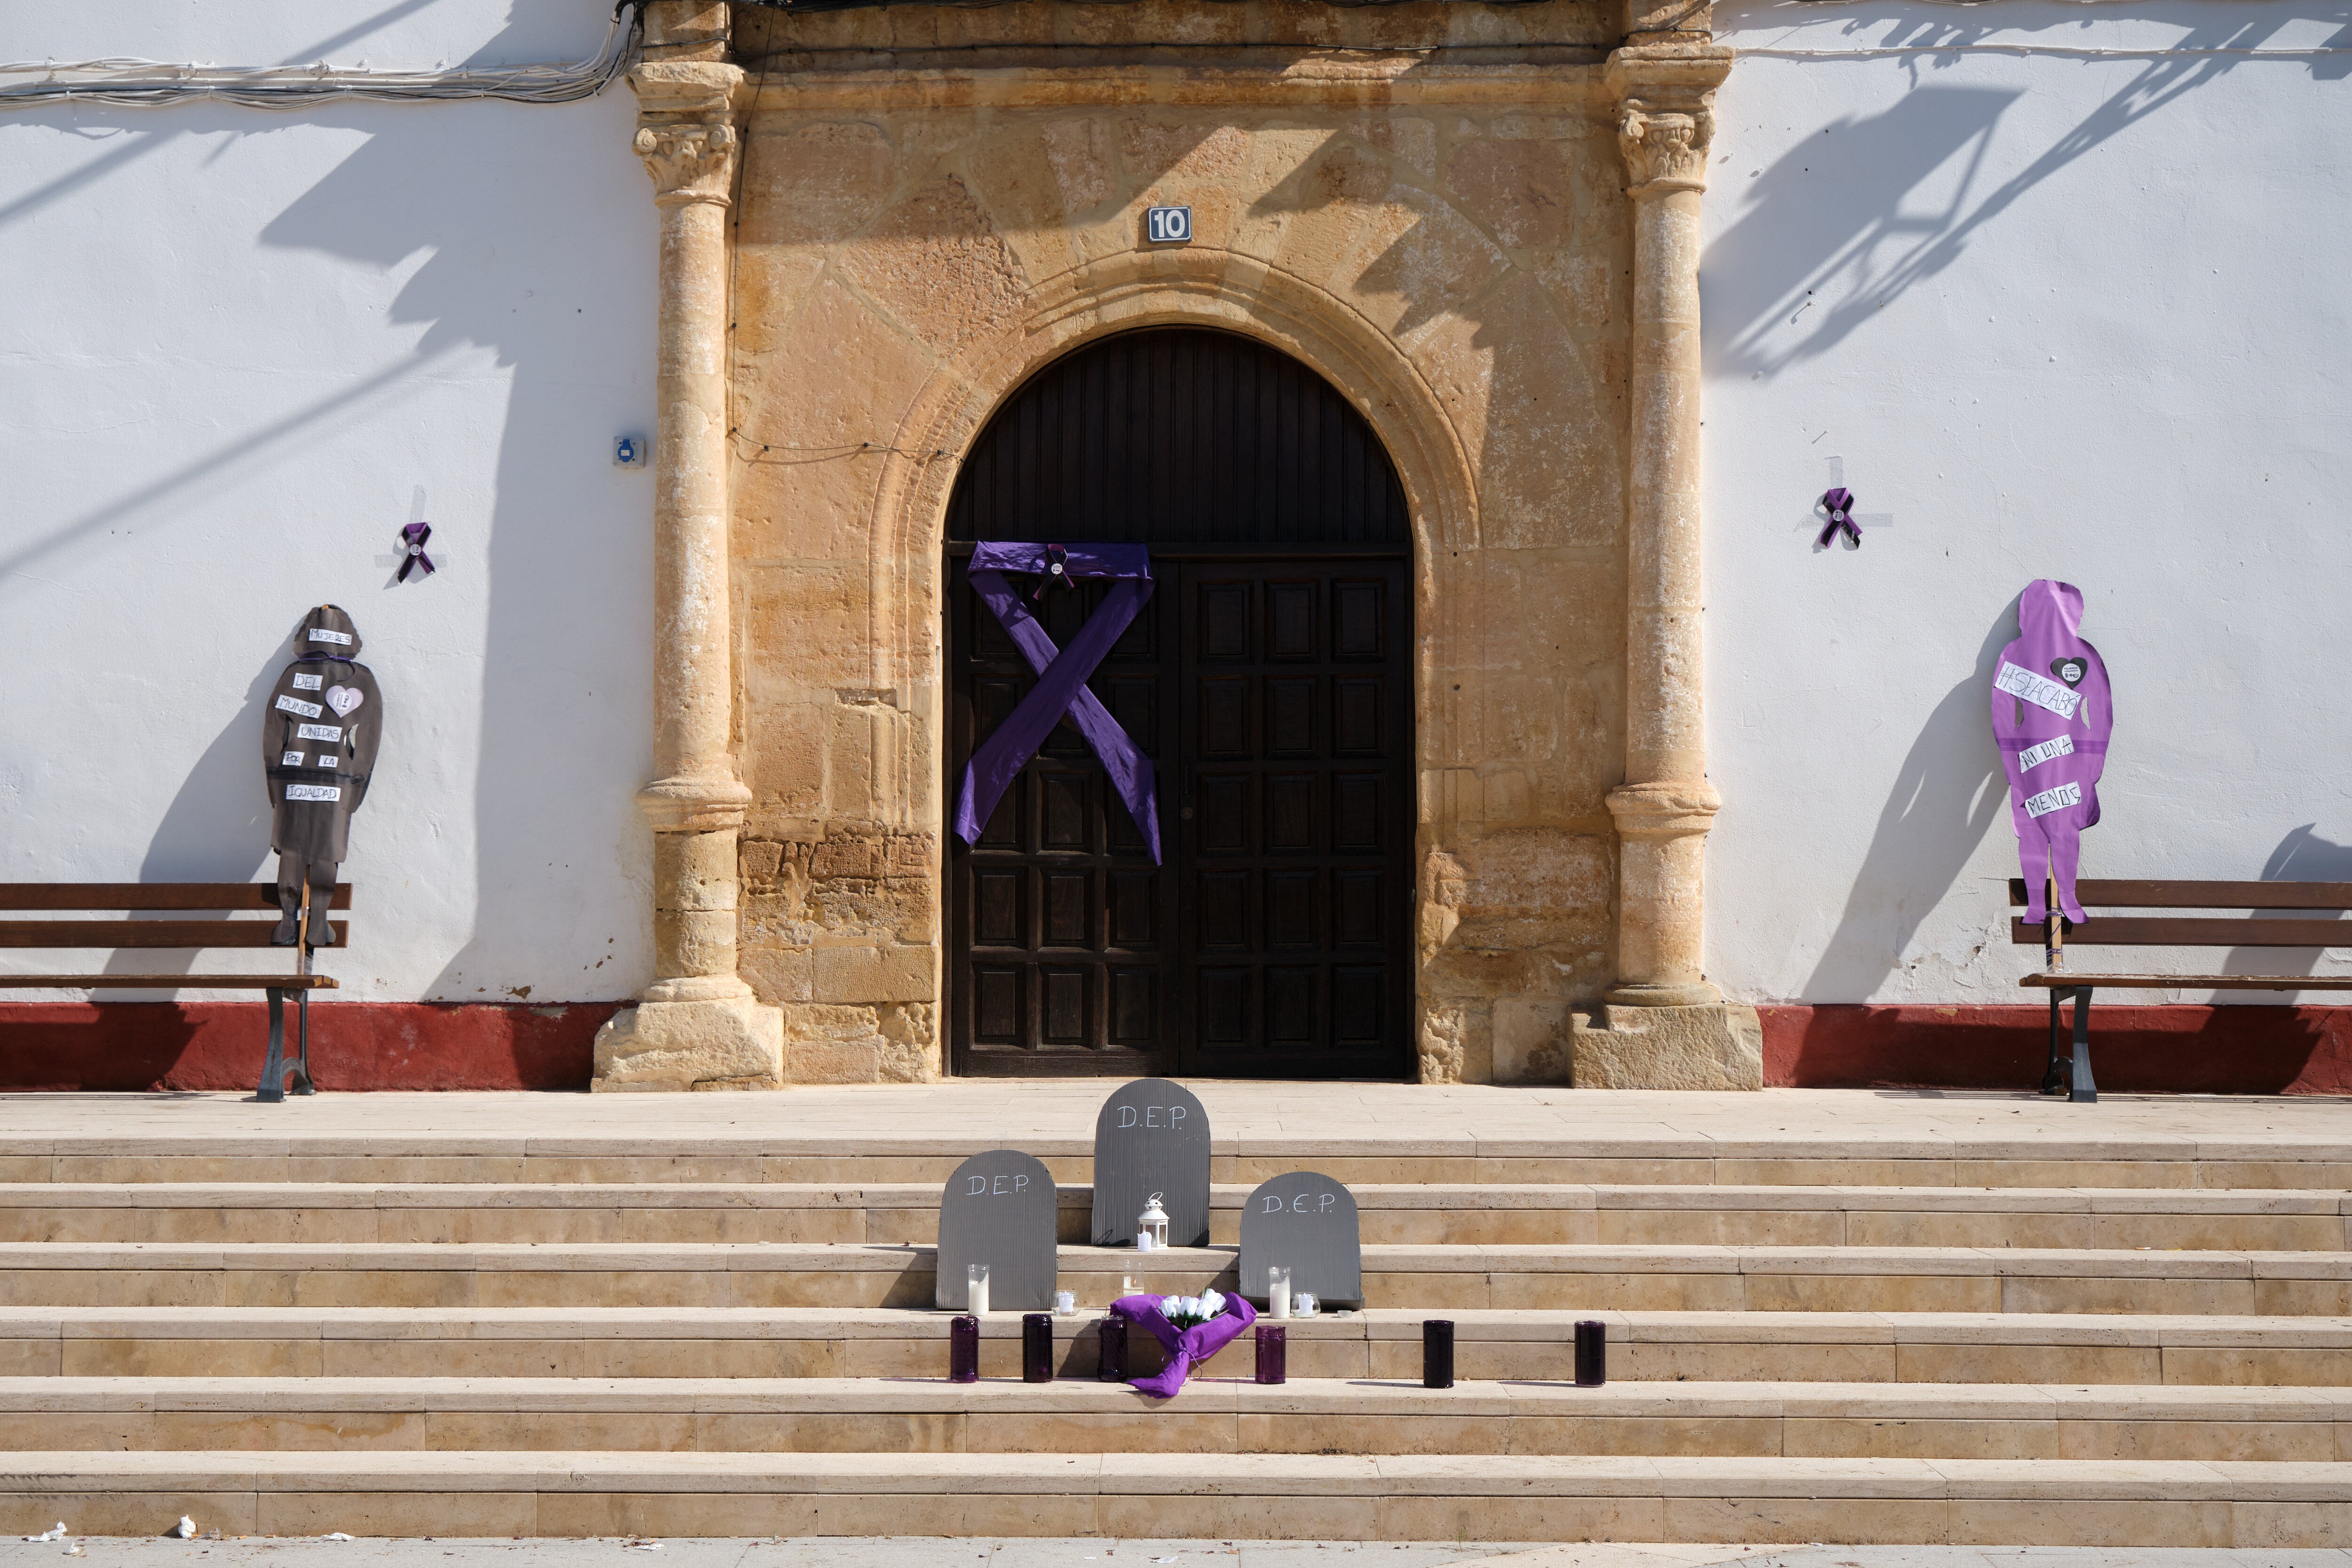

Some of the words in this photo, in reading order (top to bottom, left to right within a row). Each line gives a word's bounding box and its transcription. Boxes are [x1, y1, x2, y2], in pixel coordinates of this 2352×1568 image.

[1154, 210, 1185, 238] 10
[311, 629, 350, 643] MUJERES
[295, 675, 319, 688] DEL
[2000, 666, 2081, 716] #SEACABÓ
[280, 697, 317, 716] MUNDO
[301, 727, 339, 739] UNIDAS
[286, 753, 301, 763] POR
[324, 757, 334, 766] LA
[2021, 751, 2037, 768] NI
[2041, 737, 2071, 758] UNA
[289, 785, 337, 799] IGUALDAD
[2027, 786, 2081, 815] MENOS
[1117, 1106, 1186, 1130] D.E.P.
[1262, 1194, 1335, 1213] D.E.P.
